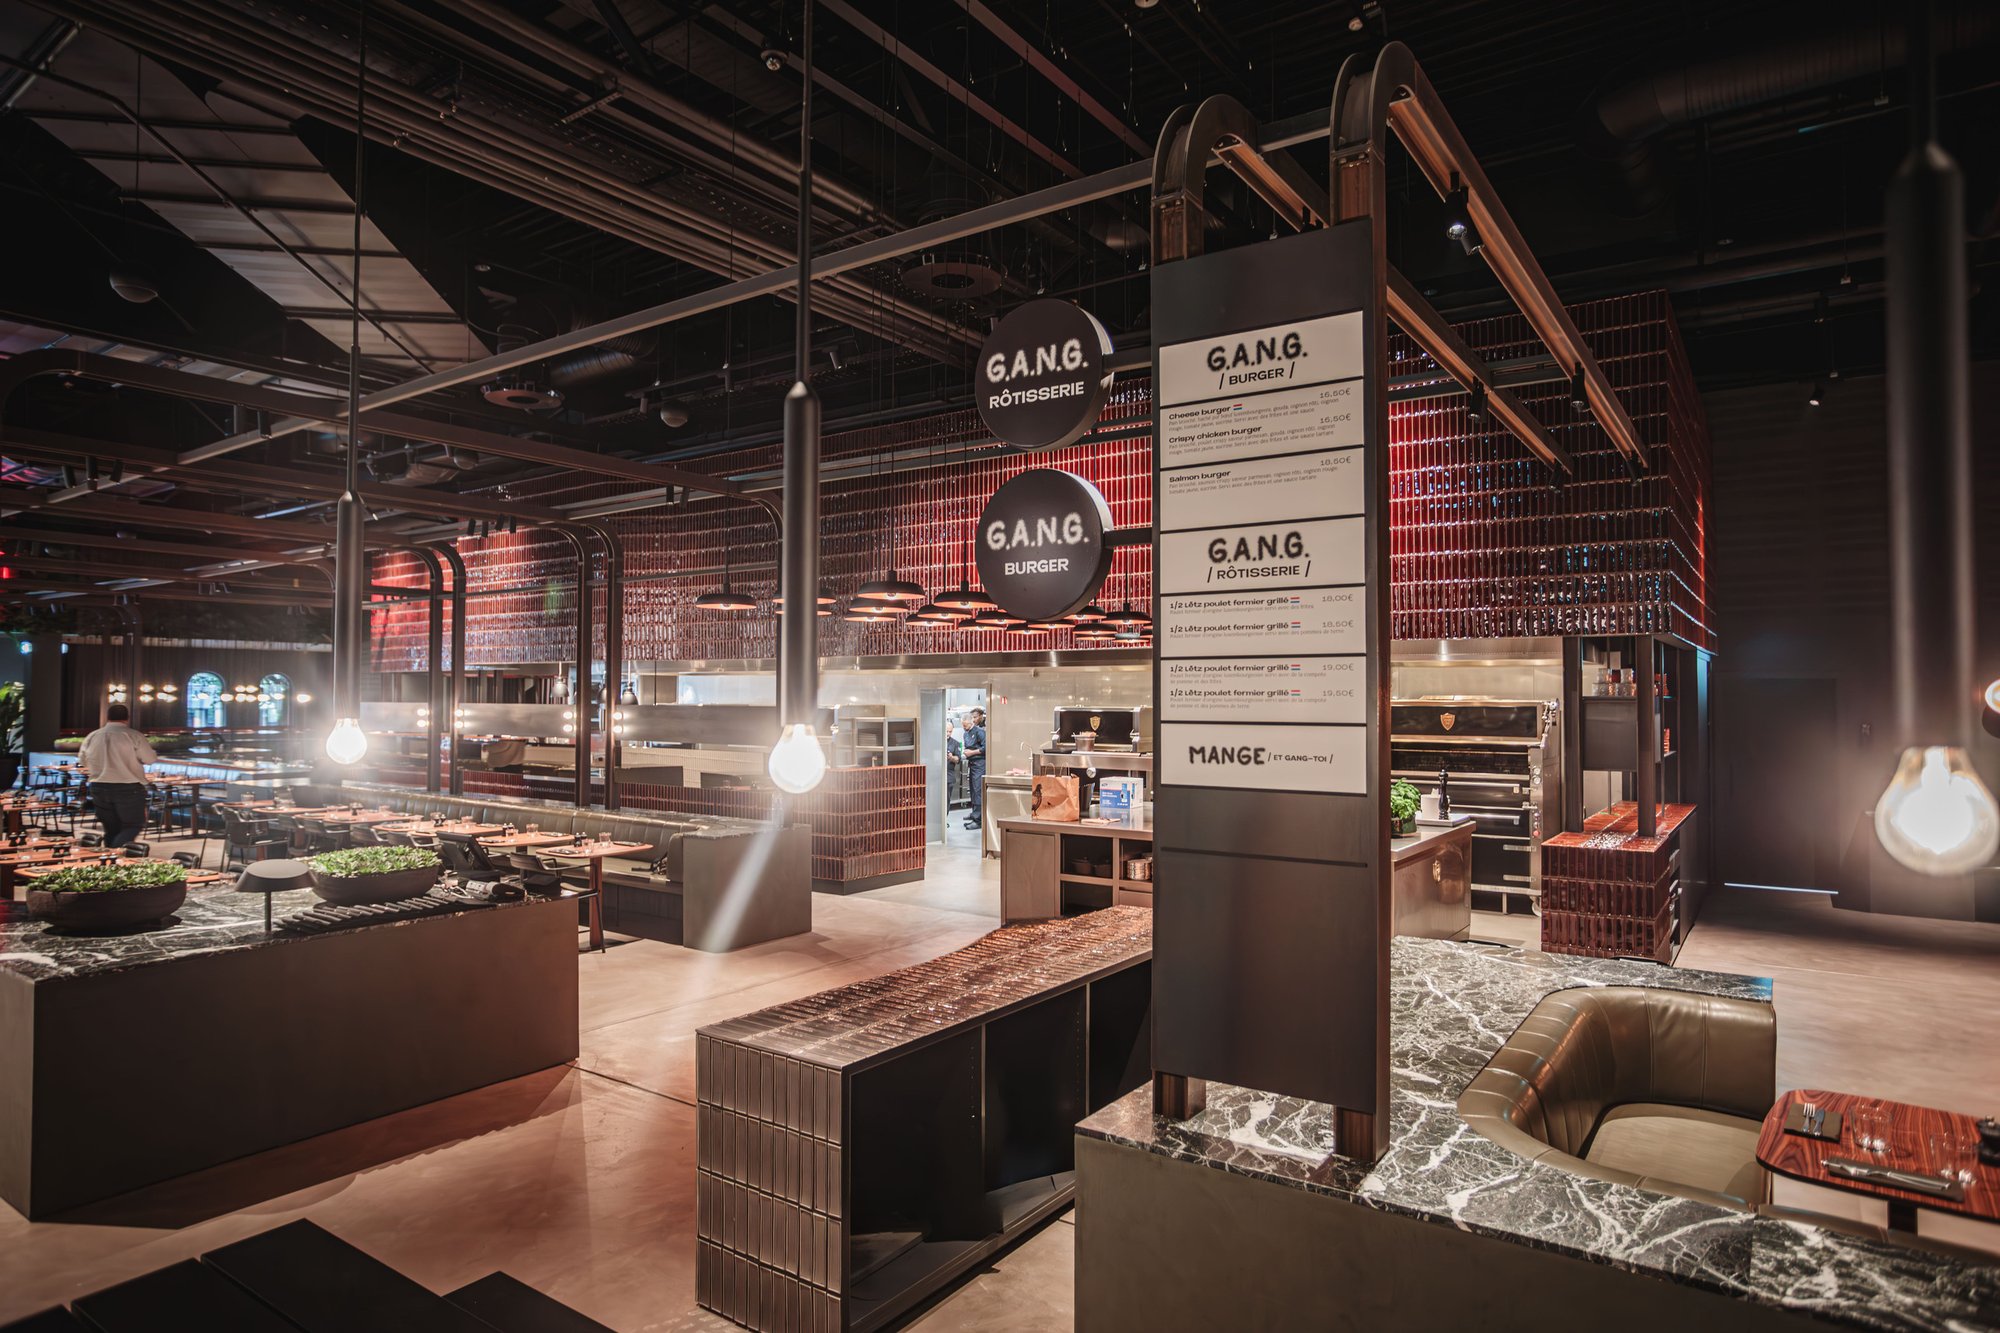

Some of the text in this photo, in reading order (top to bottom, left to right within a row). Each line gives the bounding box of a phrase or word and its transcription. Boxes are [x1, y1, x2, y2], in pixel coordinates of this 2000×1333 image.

[986, 338, 1089, 383] G.A.N.G.
[1207, 332, 1308, 372] G.A.N.G.
[1229, 367, 1285, 385] BURGER
[989, 381, 1085, 409] RÔTISSERIE
[1169, 406, 1231, 420] Cheese burger
[1169, 426, 1262, 444] Crispy chicken burger
[1169, 470, 1231, 483] Salmon burger
[986, 512, 1090, 550] G.A.N.G.
[1208, 531, 1310, 563] G.A.N.G.
[1004, 558, 1069, 576] BURGER
[1217, 565, 1300, 580] RÔTISSERIE
[1170, 601, 1183, 609] 1/2
[1204, 600, 1231, 610] poulet
[1233, 598, 1264, 606] fermier
[1266, 597, 1289, 607] grillé
[1170, 625, 1183, 633] 1/2
[1204, 624, 1231, 634] poulet
[1233, 622, 1264, 632] fermier
[1266, 621, 1289, 632] grillé
[1170, 665, 1183, 673] 1/2
[1204, 664, 1231, 674] poulet
[1233, 663, 1264, 672] fermier
[1266, 663, 1289, 673] grillé
[1170, 690, 1183, 698] 1/2
[1204, 689, 1231, 698] poulet
[1233, 689, 1264, 697] fermier
[1266, 688, 1289, 698] grillé
[1188, 745, 1266, 765] MANGE
[1284, 754, 1327, 762] GANG-TOI
